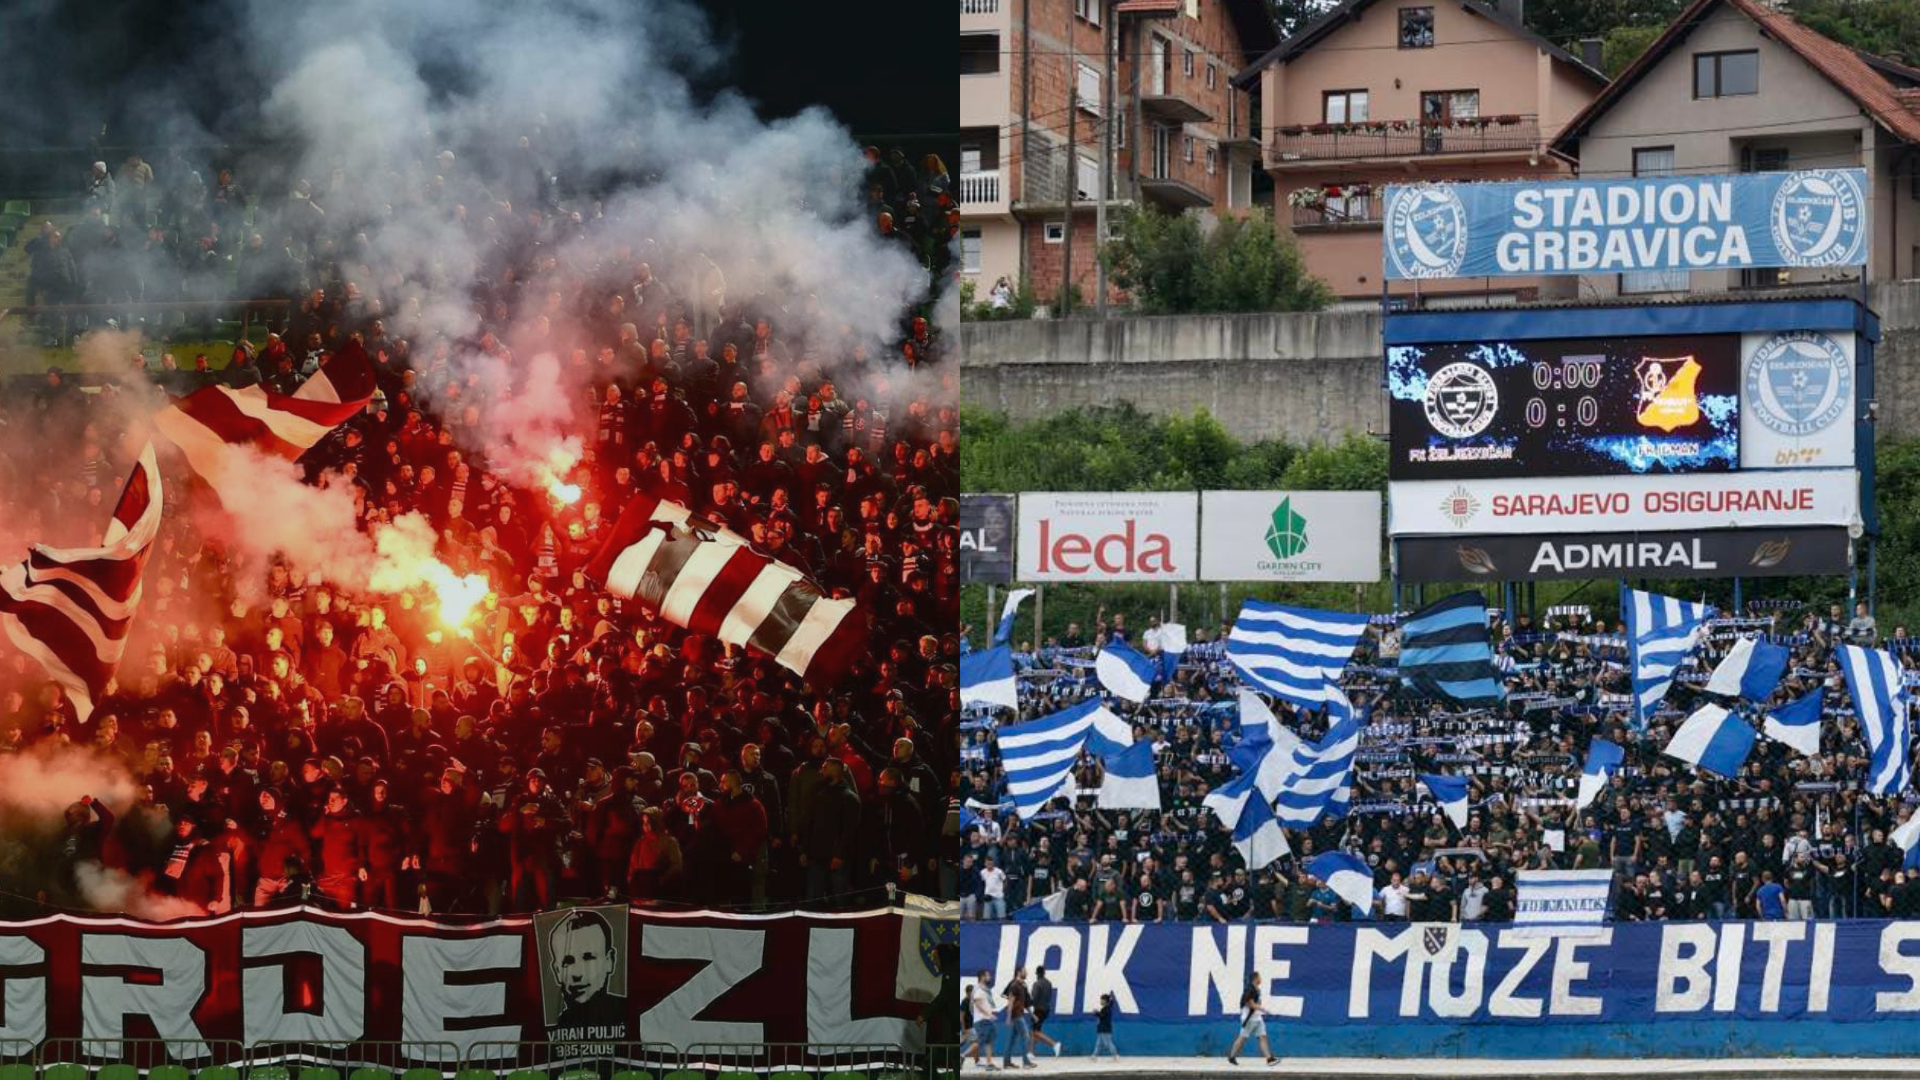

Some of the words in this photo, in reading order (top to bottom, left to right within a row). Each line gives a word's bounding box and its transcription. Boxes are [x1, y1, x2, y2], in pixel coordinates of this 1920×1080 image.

[1513, 183, 1731, 228] STADION
[1496, 225, 1752, 273] GRBAVICA
[1533, 361, 1600, 390] 0:00
[1492, 492, 1630, 516] SARAJEVO
[1643, 488, 1814, 513] OSIGURANJE
[960, 528, 997, 552] AL
[1037, 518, 1177, 574] leda
[1529, 537, 1717, 573] ADMIRAL
[1188, 925, 1309, 1017] NE
[1655, 922, 1836, 1014] BITI
[587, 1022, 626, 1040] PULJIĆ
